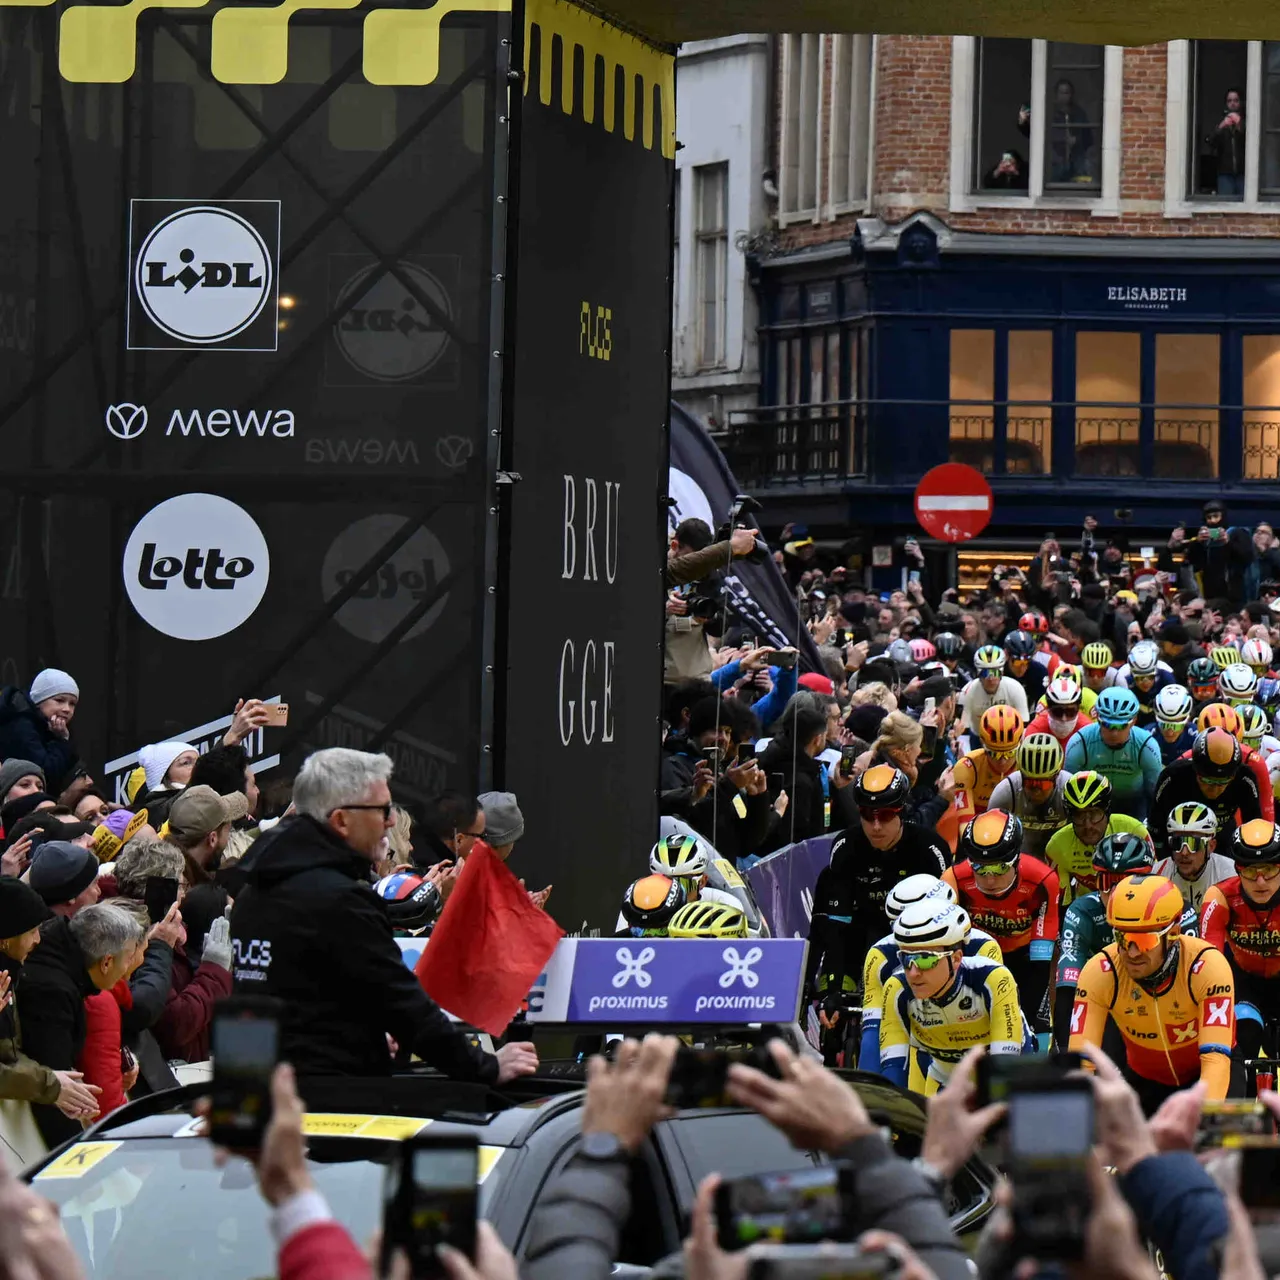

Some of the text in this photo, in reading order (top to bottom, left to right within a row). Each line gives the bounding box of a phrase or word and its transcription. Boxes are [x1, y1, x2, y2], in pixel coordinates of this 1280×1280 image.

[166, 408, 295, 437] mewa
[562, 474, 621, 584] BRU
[559, 639, 614, 746] GGE
[1075, 989, 1088, 998] no
[1206, 984, 1231, 996] Uno
[589, 995, 776, 1013] proximus proximus
[1206, 999, 1231, 1025] X
[949, 1032, 991, 1042] Flander
